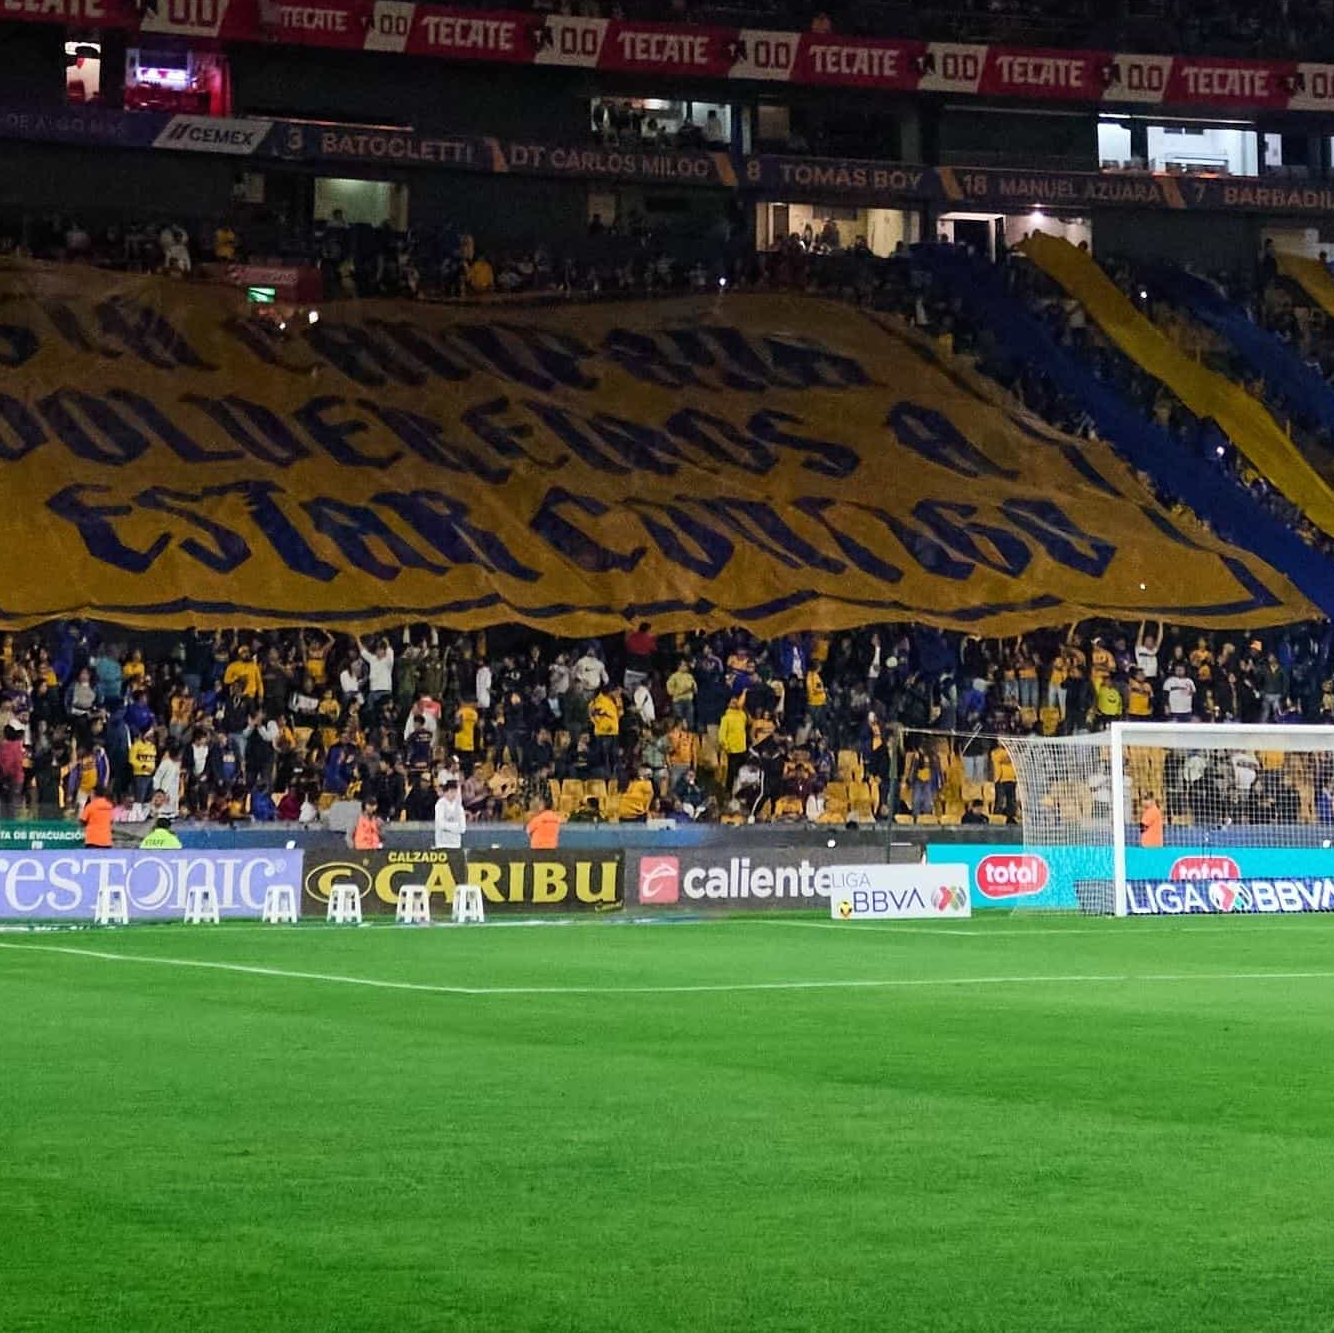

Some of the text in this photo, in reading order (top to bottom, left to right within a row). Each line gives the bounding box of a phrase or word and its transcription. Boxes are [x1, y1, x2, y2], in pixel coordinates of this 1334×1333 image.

[281, 6, 347, 33] TECATE
[422, 16, 515, 50] TECATE
[617, 31, 710, 65] TECATE
[809, 44, 900, 77] TECATE
[996, 55, 1084, 87] TECATE
[1181, 66, 1269, 97] TECATE
[190, 127, 255, 145] CEMEX
[388, 851, 448, 863] CALZADO
[985, 860, 1037, 883] total
[683, 857, 831, 898] caliente
[832, 872, 870, 889] LIGA
[853, 887, 925, 913] BBVA
[1128, 882, 1208, 913] LIGA
